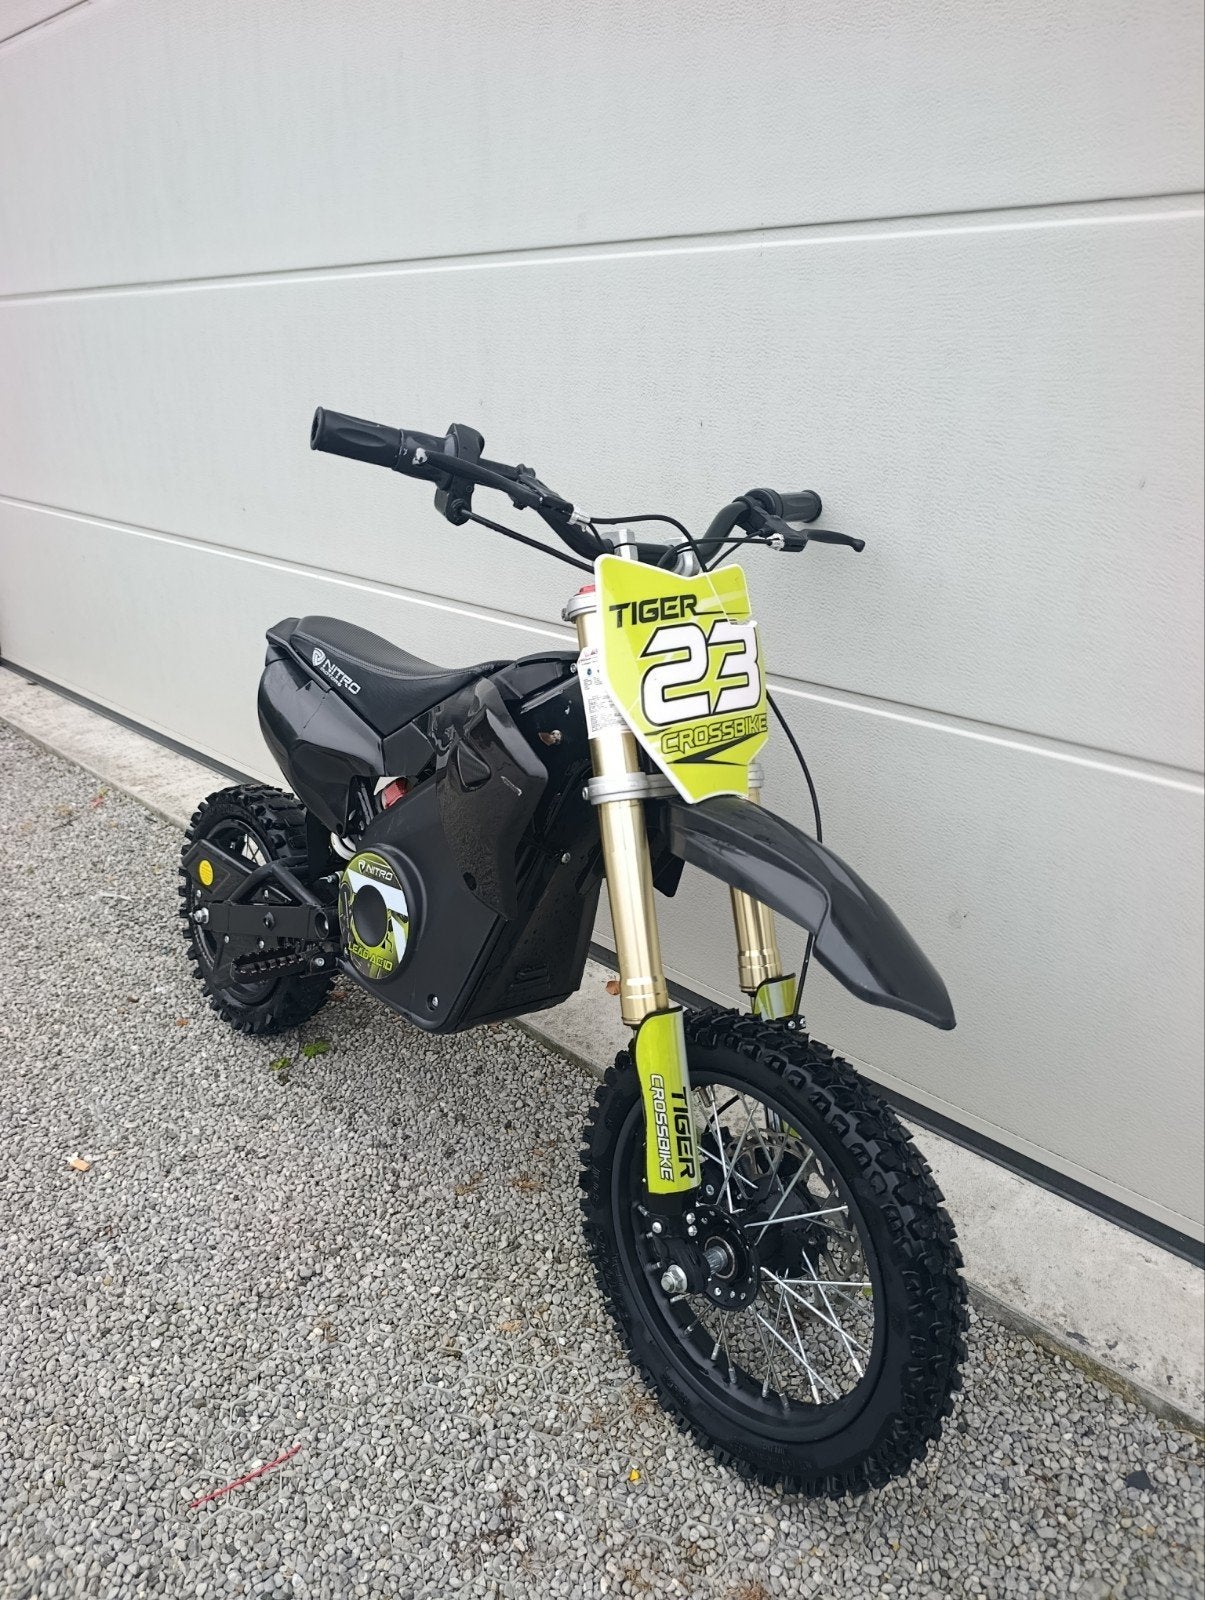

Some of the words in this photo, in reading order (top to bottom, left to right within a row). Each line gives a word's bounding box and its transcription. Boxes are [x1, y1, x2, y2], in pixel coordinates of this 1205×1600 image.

[609, 594, 699, 628] TIGER
[322, 659, 361, 695] NITRO
[640, 618, 761, 727] 23
[661, 713, 768, 755] CROSSBIKE
[365, 863, 394, 881] NITRO
[650, 1073, 675, 1183] CROSSBIKE
[671, 1086, 696, 1179] TIGER
